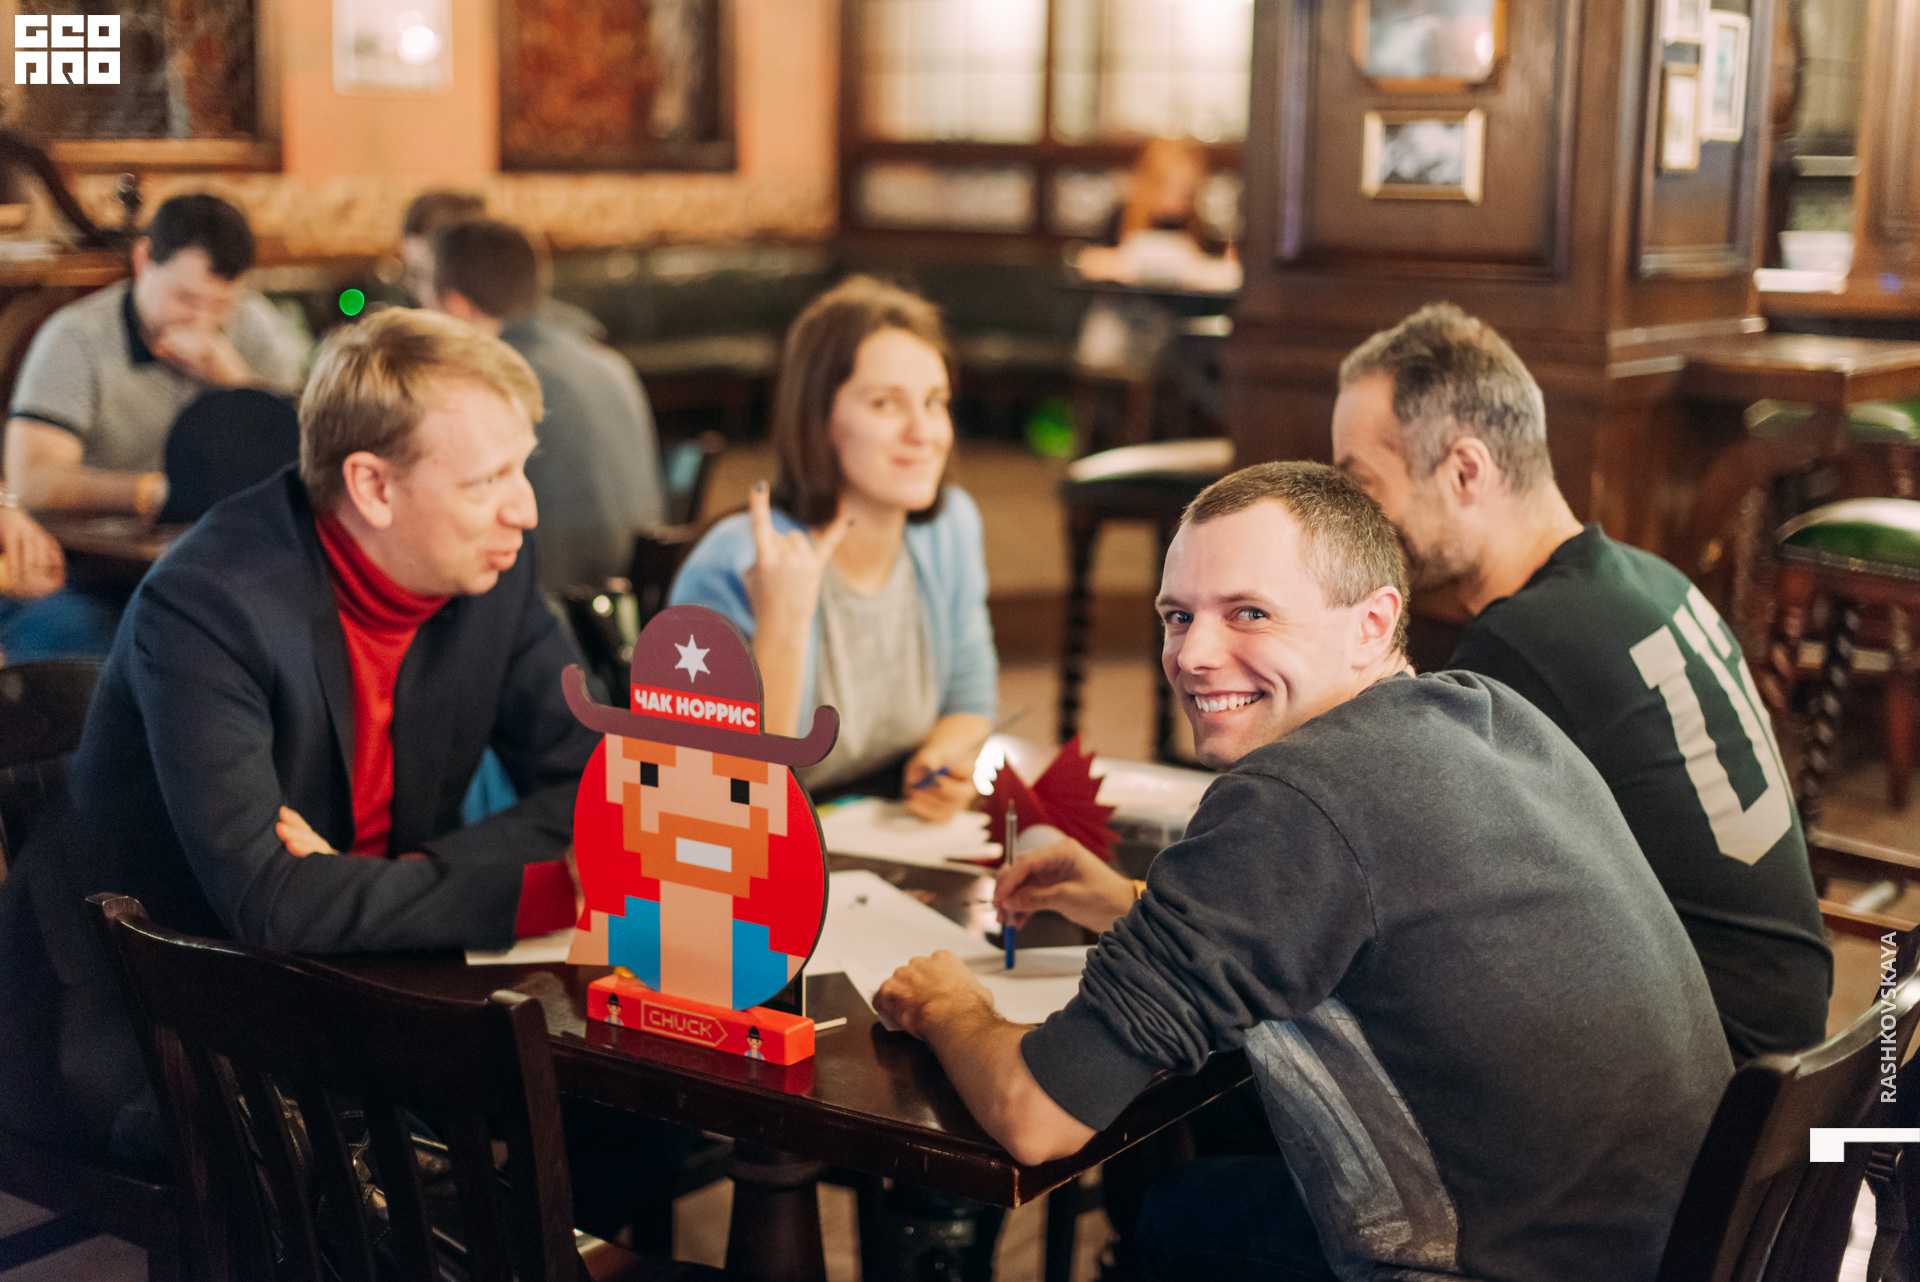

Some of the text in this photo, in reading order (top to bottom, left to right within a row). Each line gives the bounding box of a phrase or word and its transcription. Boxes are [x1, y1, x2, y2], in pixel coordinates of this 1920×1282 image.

[635, 689, 756, 727] ЧАК НОРРИС
[649, 1010, 713, 1038] CHUCK
